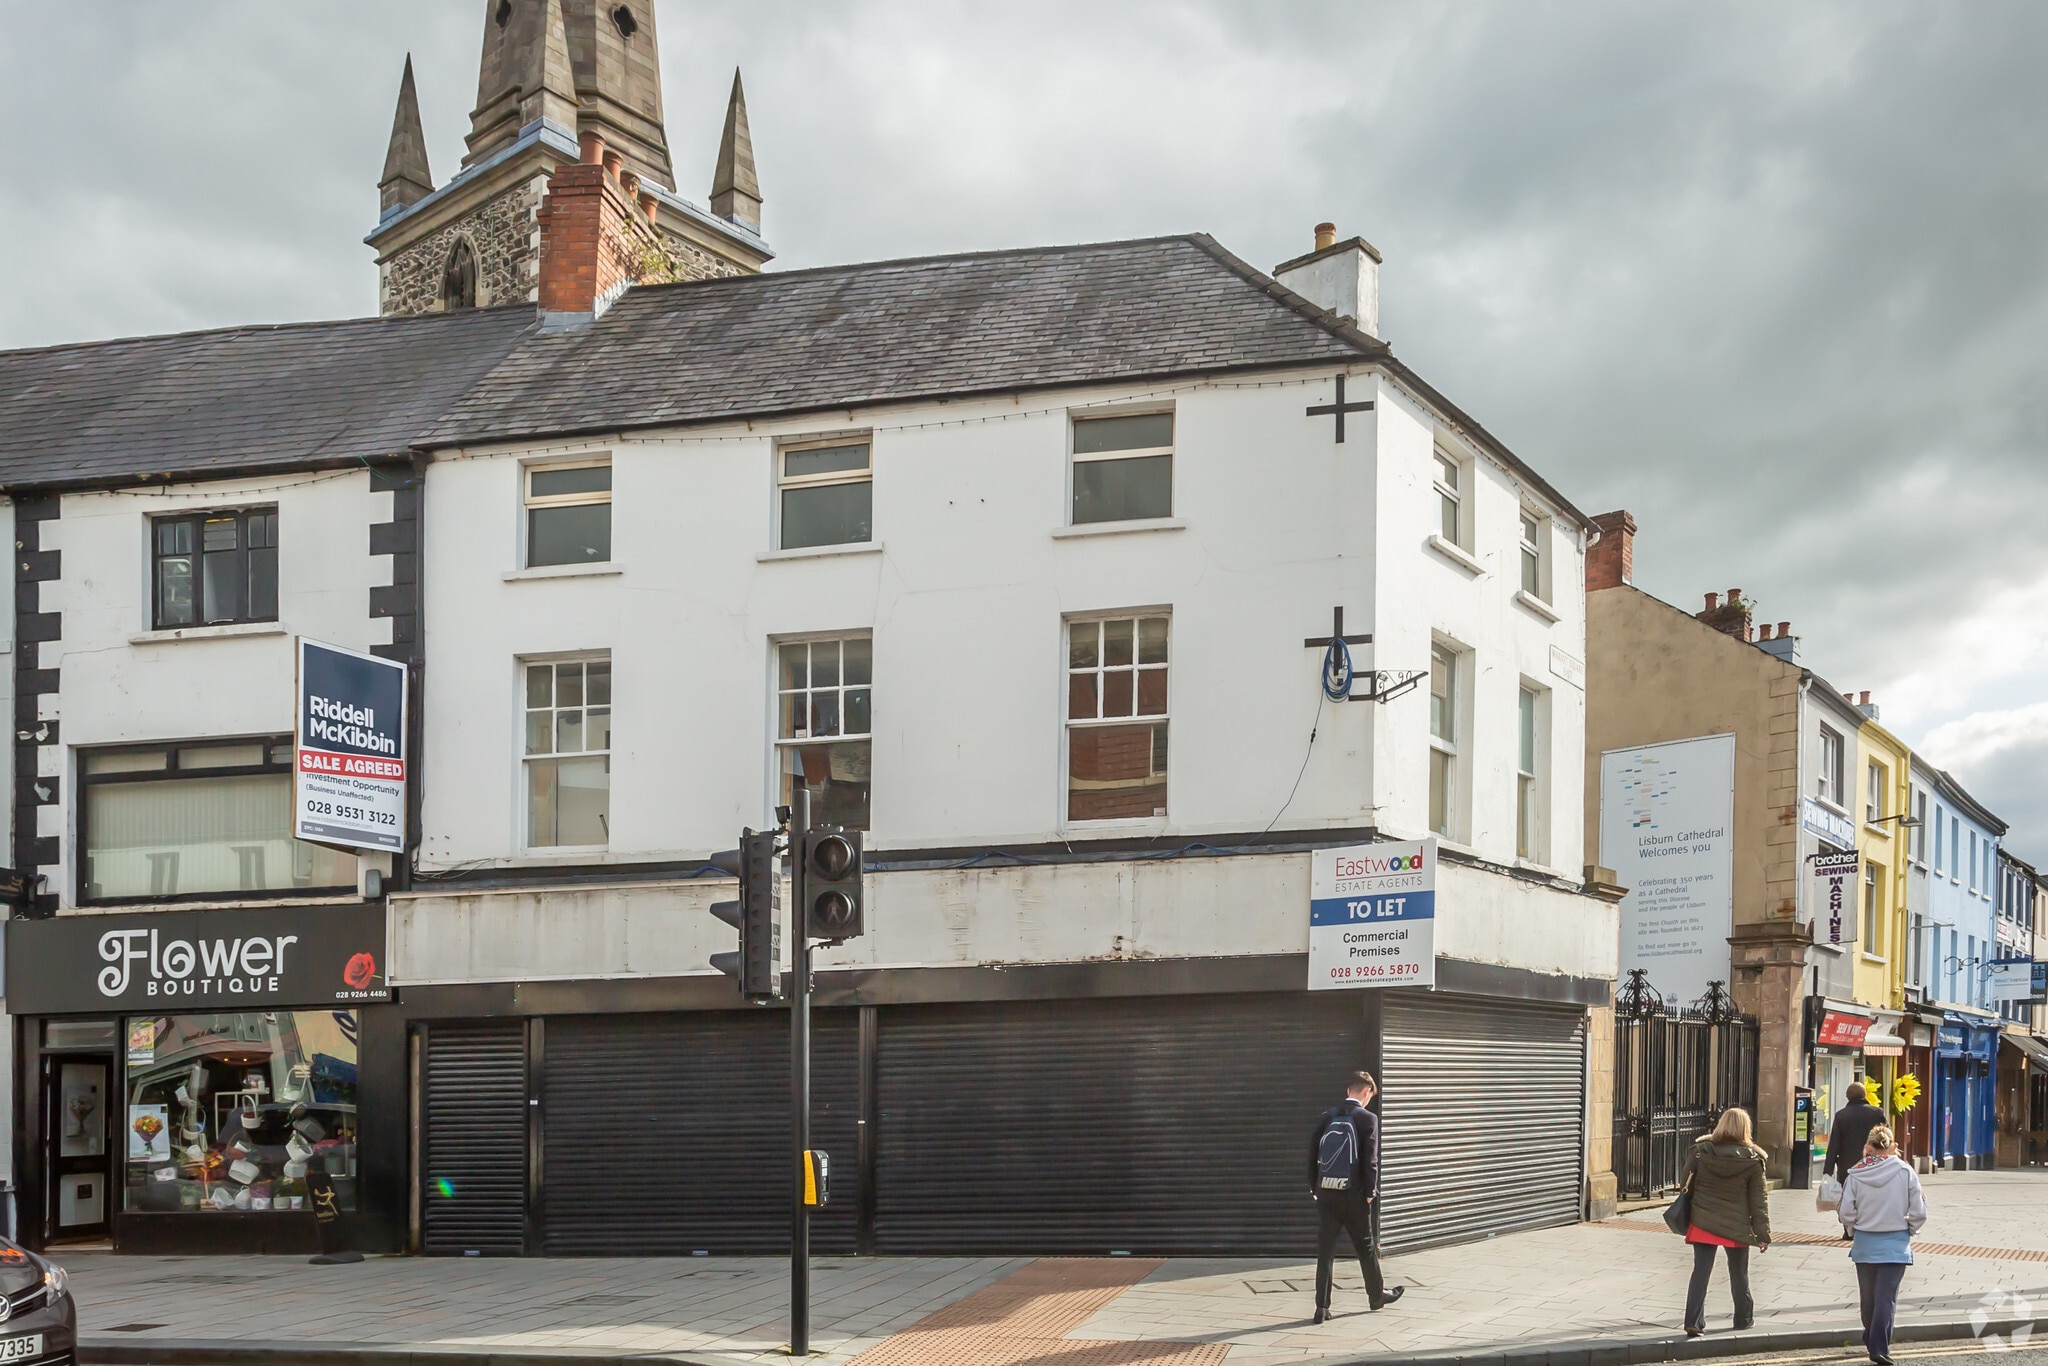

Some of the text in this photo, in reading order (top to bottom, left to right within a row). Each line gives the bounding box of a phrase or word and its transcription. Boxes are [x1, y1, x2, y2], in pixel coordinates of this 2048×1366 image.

[310, 696, 374, 728] Riddell
[310, 718, 395, 755] McKibbin
[302, 754, 402, 777] SALE AGREED
[306, 773, 400, 797] Investment Opportunity
[306, 784, 374, 802] (Business Unaffected)
[307, 800, 396, 826] 028 9531 3122
[1804, 801, 1829, 831] SEWING
[1830, 813, 1854, 846] MACHINES
[1638, 827, 1724, 846] Lisburn Cathedral
[1639, 844, 1711, 858] Welcomes you
[1815, 853, 1858, 866] brother
[1336, 845, 1424, 877] Eastwood
[1815, 865, 1858, 876] SEWING
[1336, 876, 1423, 892] ESTATE AGENTS
[1638, 874, 1714, 887] Celebrating 350 years
[1655, 886, 1688, 896] Cathedral
[1347, 898, 1406, 919] TO LET
[1660, 904, 1678, 912] people
[1829, 877, 1843, 942] MACHINES
[1343, 928, 1408, 944] Commercial
[1350, 946, 1400, 958] Premises
[98, 928, 298, 997] Flower
[1330, 964, 1419, 978] 028 9266 5870
[147, 976, 279, 996] BOUTIQUE
[1797, 1100, 1804, 1110] P
[1321, 1176, 1348, 1190] NIKE
[0, 1337, 34, 1358] 7335
